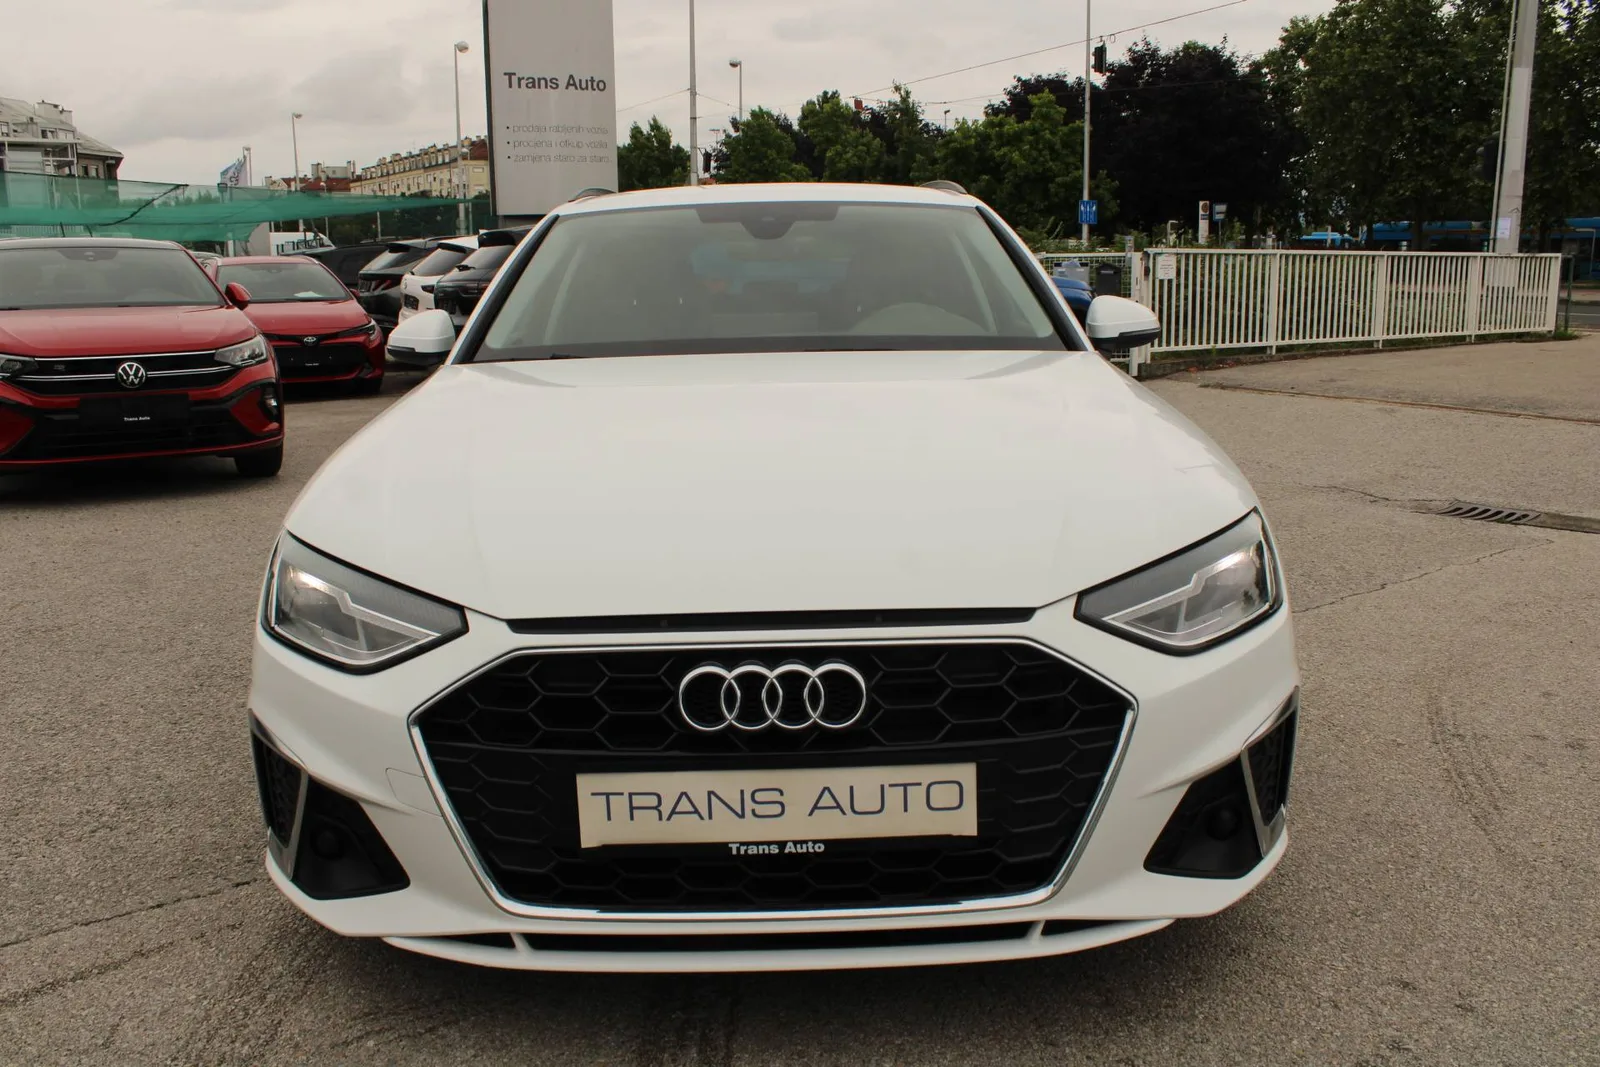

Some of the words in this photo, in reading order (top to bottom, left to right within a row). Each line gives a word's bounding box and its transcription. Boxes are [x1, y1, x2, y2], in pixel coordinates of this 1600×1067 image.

[503, 72, 559, 90] Trans
[565, 74, 607, 92] Auto
[512, 124, 547, 135] prodaja
[549, 124, 584, 135] rabljenih
[513, 140, 553, 150] procjena
[559, 140, 584, 150] otkup
[585, 140, 608, 149] vozila
[513, 154, 551, 164] zamjena
[576, 155, 587, 163] za
[591, 787, 786, 822] TRANS
[807, 779, 964, 817] AUTO
[728, 842, 780, 856] Trans
[784, 841, 825, 854] Auto
